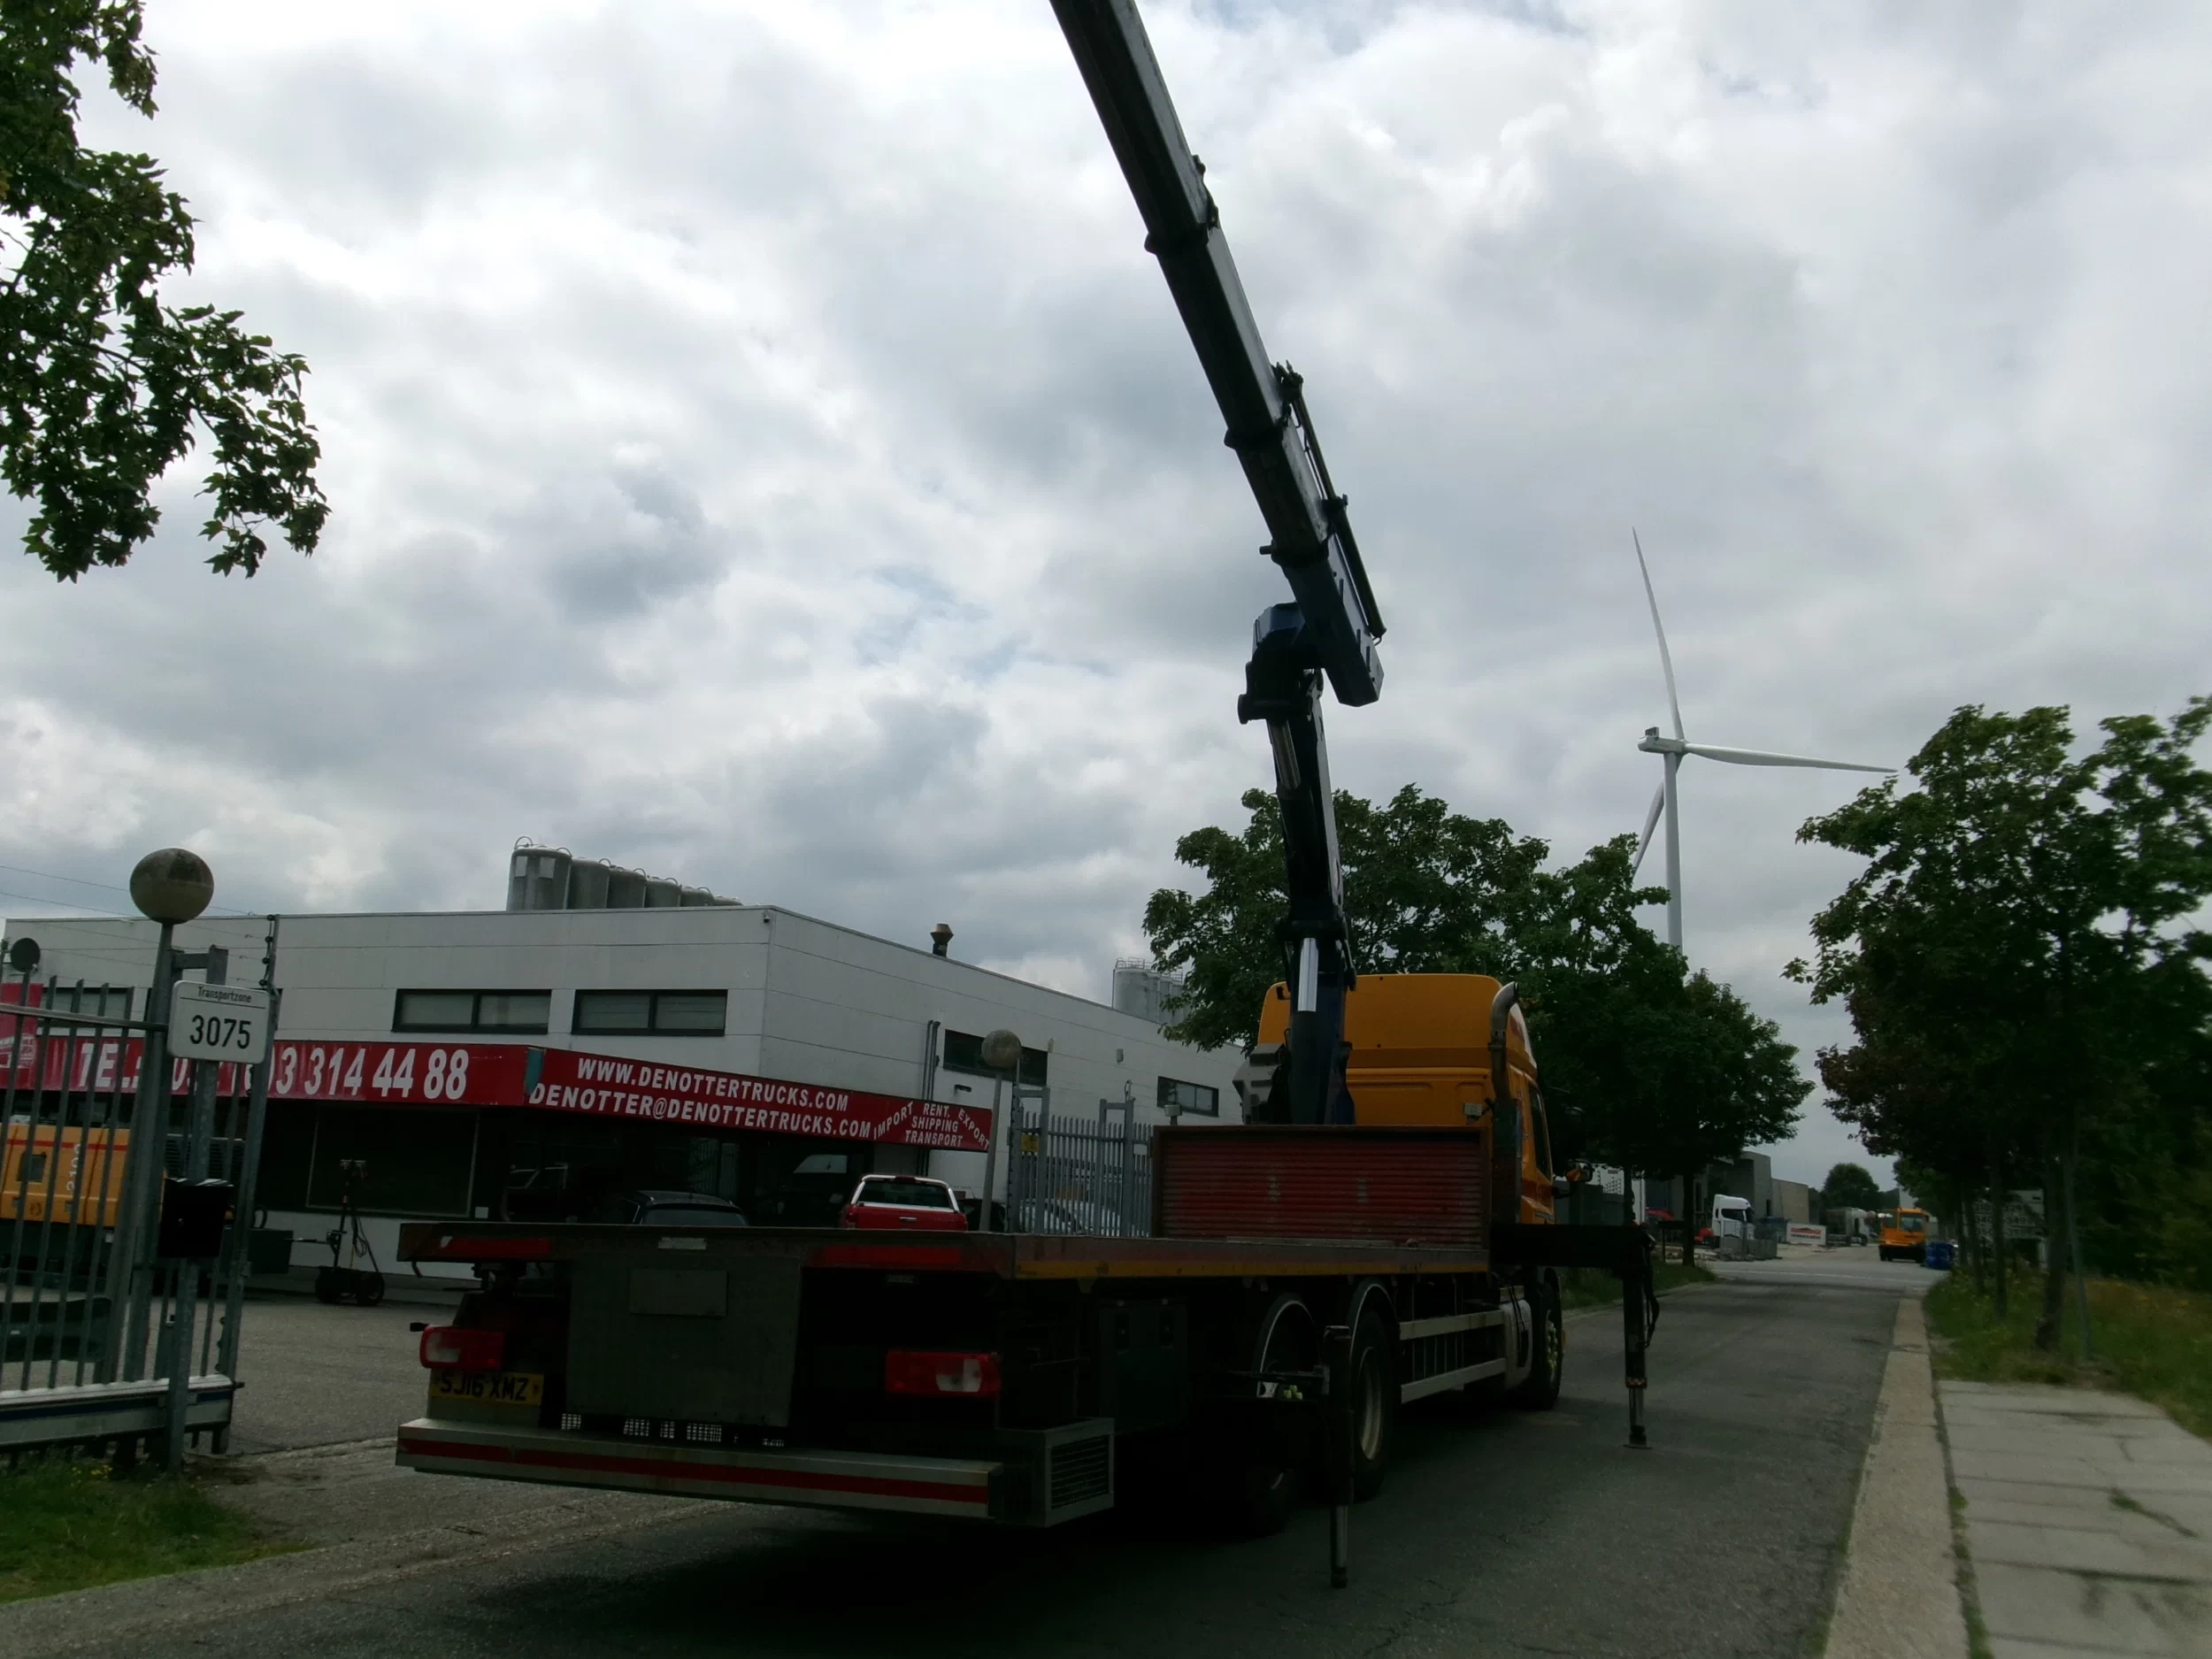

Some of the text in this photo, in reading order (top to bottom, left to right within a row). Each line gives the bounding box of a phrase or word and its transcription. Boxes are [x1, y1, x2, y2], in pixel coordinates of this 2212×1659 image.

[197, 986, 252, 1003] Transportzone
[190, 1015, 251, 1049] 3075
[303, 1047, 366, 1096] 314
[372, 1048, 416, 1098] 44
[423, 1048, 470, 1101] 88
[577, 1057, 849, 1112] WWW.DENOTTERTRUCKS.COM
[528, 1082, 872, 1139] DENOTTER@DENOTTERTRUCKS.COM
[873, 1100, 914, 1141] IMPORT
[911, 1115, 959, 1133] SHIPPING
[958, 1107, 990, 1150] EXPORT
[905, 1129, 964, 1148] TRANSPORT
[489, 1372, 530, 1402] XMZ
